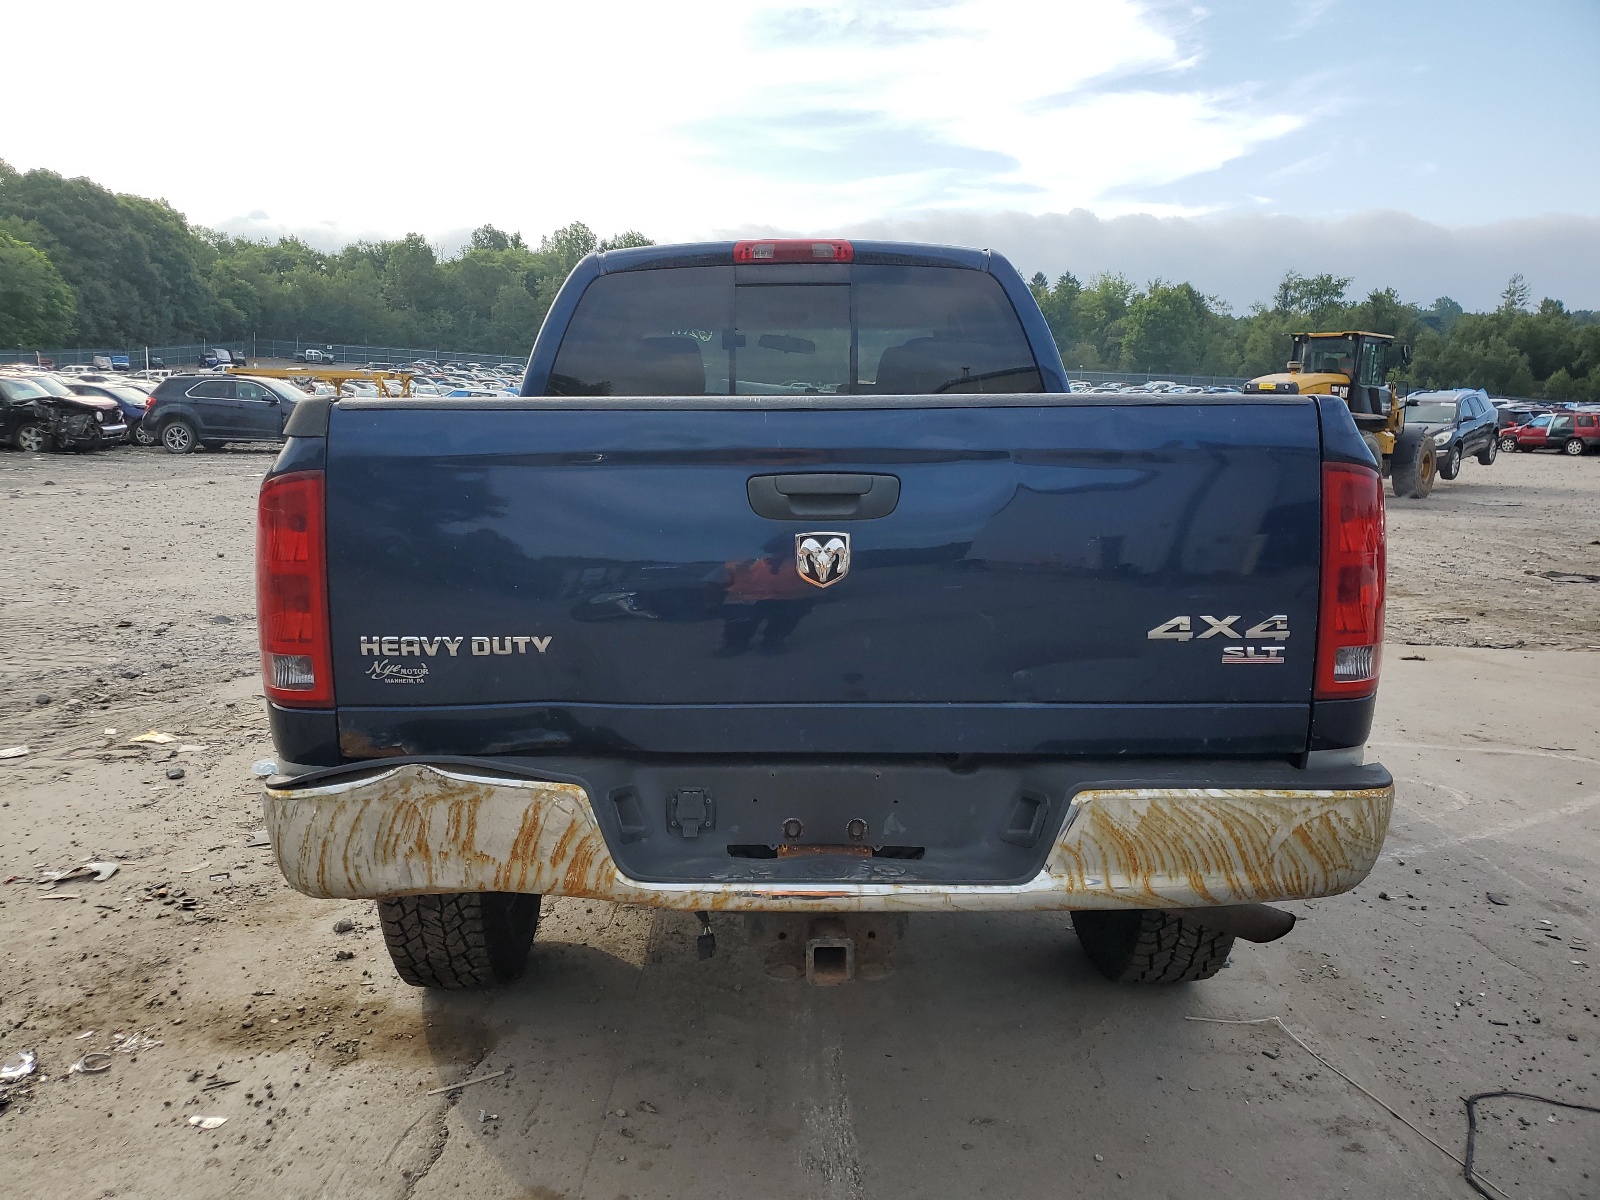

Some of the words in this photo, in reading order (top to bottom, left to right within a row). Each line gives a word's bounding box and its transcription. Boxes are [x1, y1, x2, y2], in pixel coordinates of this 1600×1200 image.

[1147, 615, 1291, 642] 4X4
[360, 636, 463, 657] HEAVY
[471, 636, 553, 656] DUTY
[1223, 646, 1285, 658] SLT
[365, 659, 401, 679] Nye
